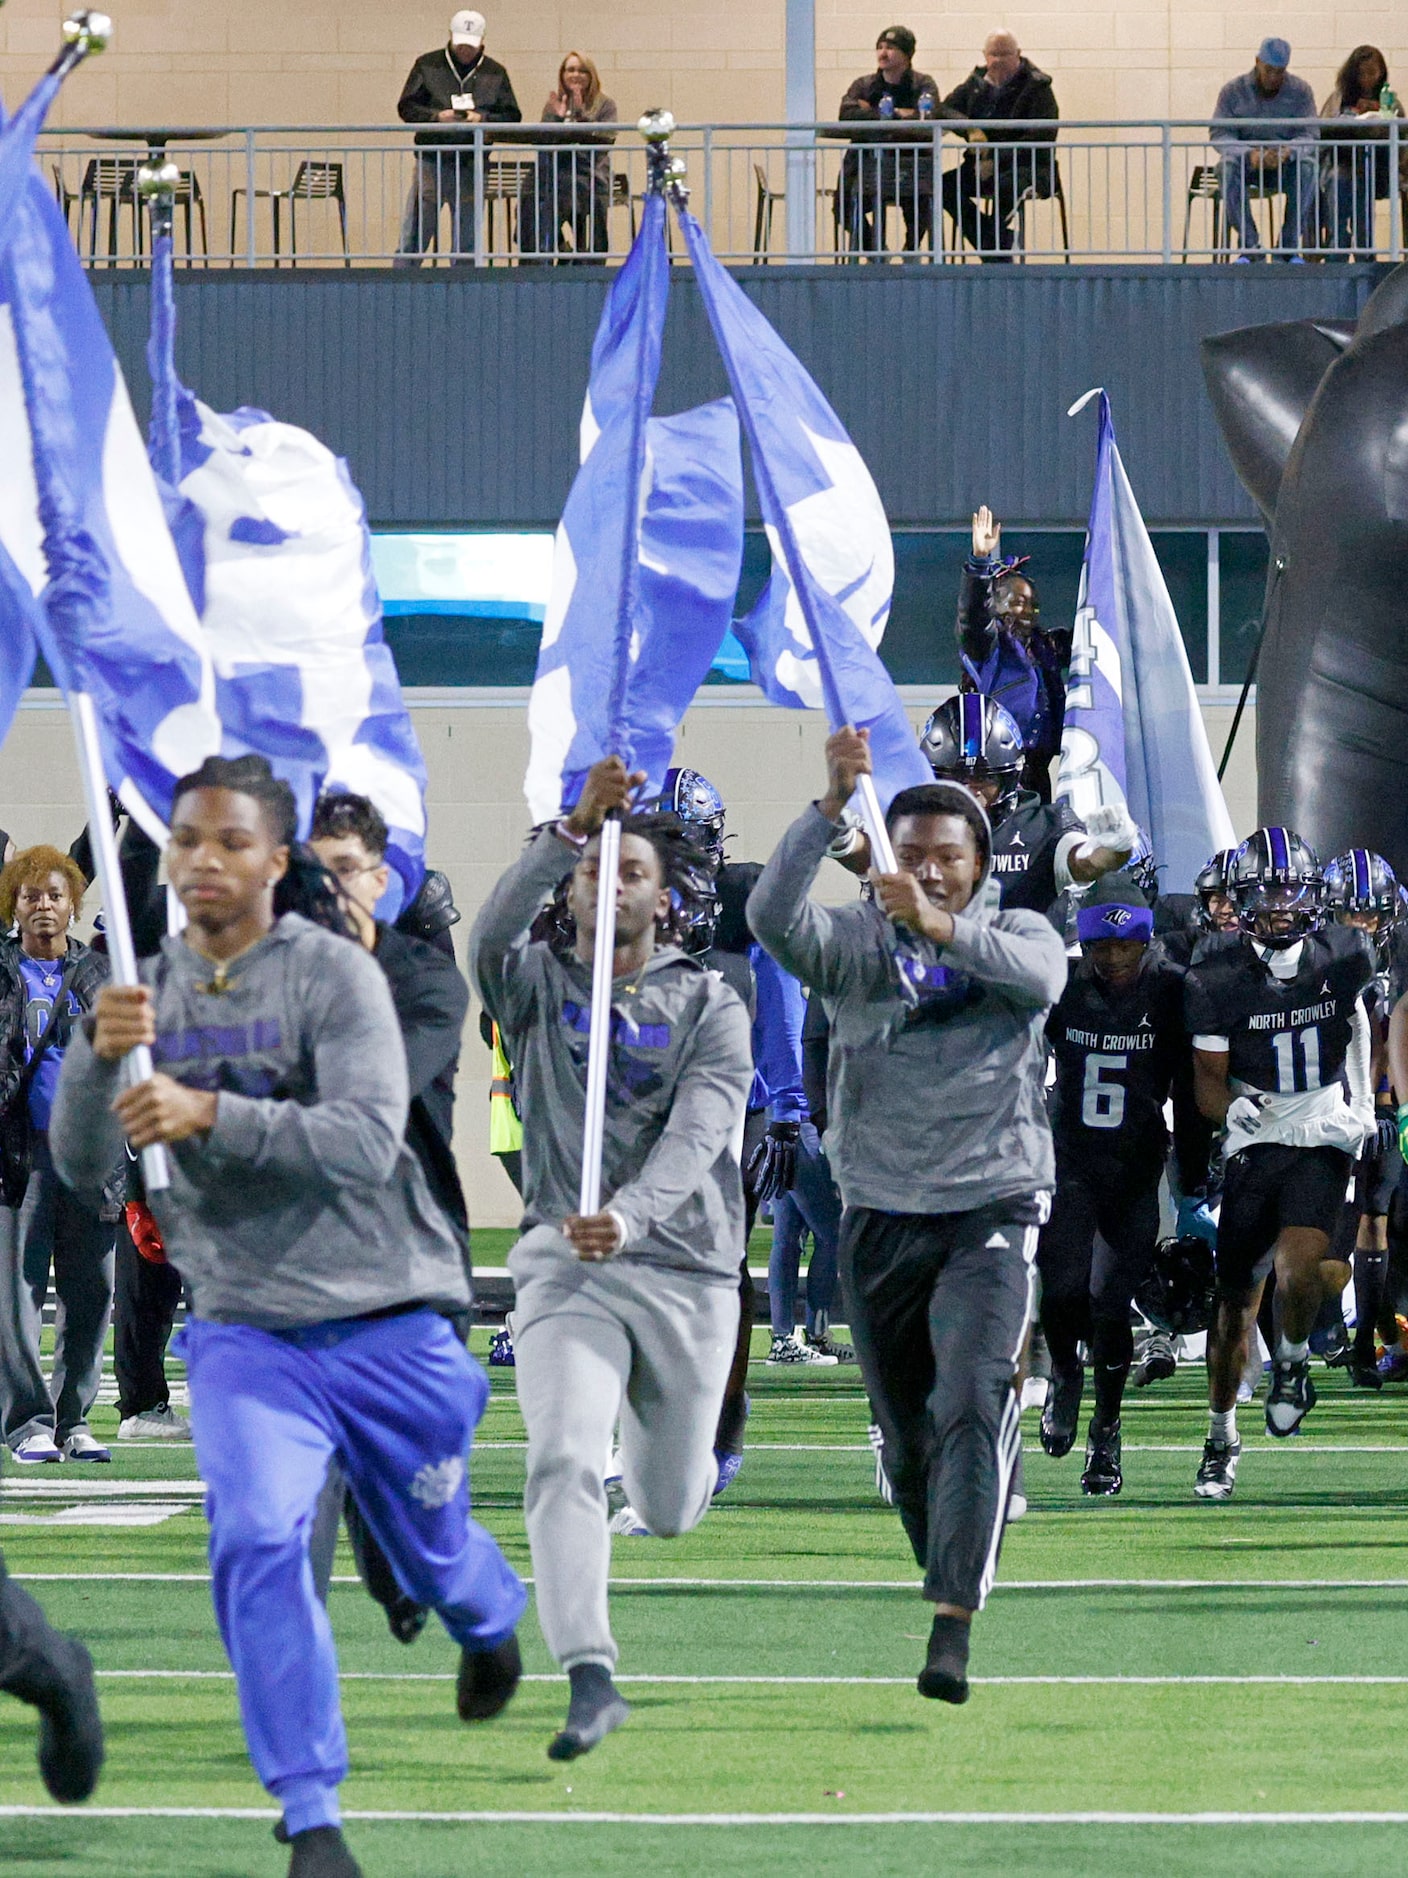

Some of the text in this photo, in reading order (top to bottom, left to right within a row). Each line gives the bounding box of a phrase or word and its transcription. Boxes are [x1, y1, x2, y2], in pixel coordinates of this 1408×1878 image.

[464, 20, 474, 31] T
[989, 854, 1030, 873] OWLEY
[1247, 999, 1337, 1030] NORTH CROWLEY
[1065, 1026, 1156, 1051] NORTH CROWLEY
[1272, 1026, 1321, 1094] 11
[1082, 1053, 1128, 1128] 6
